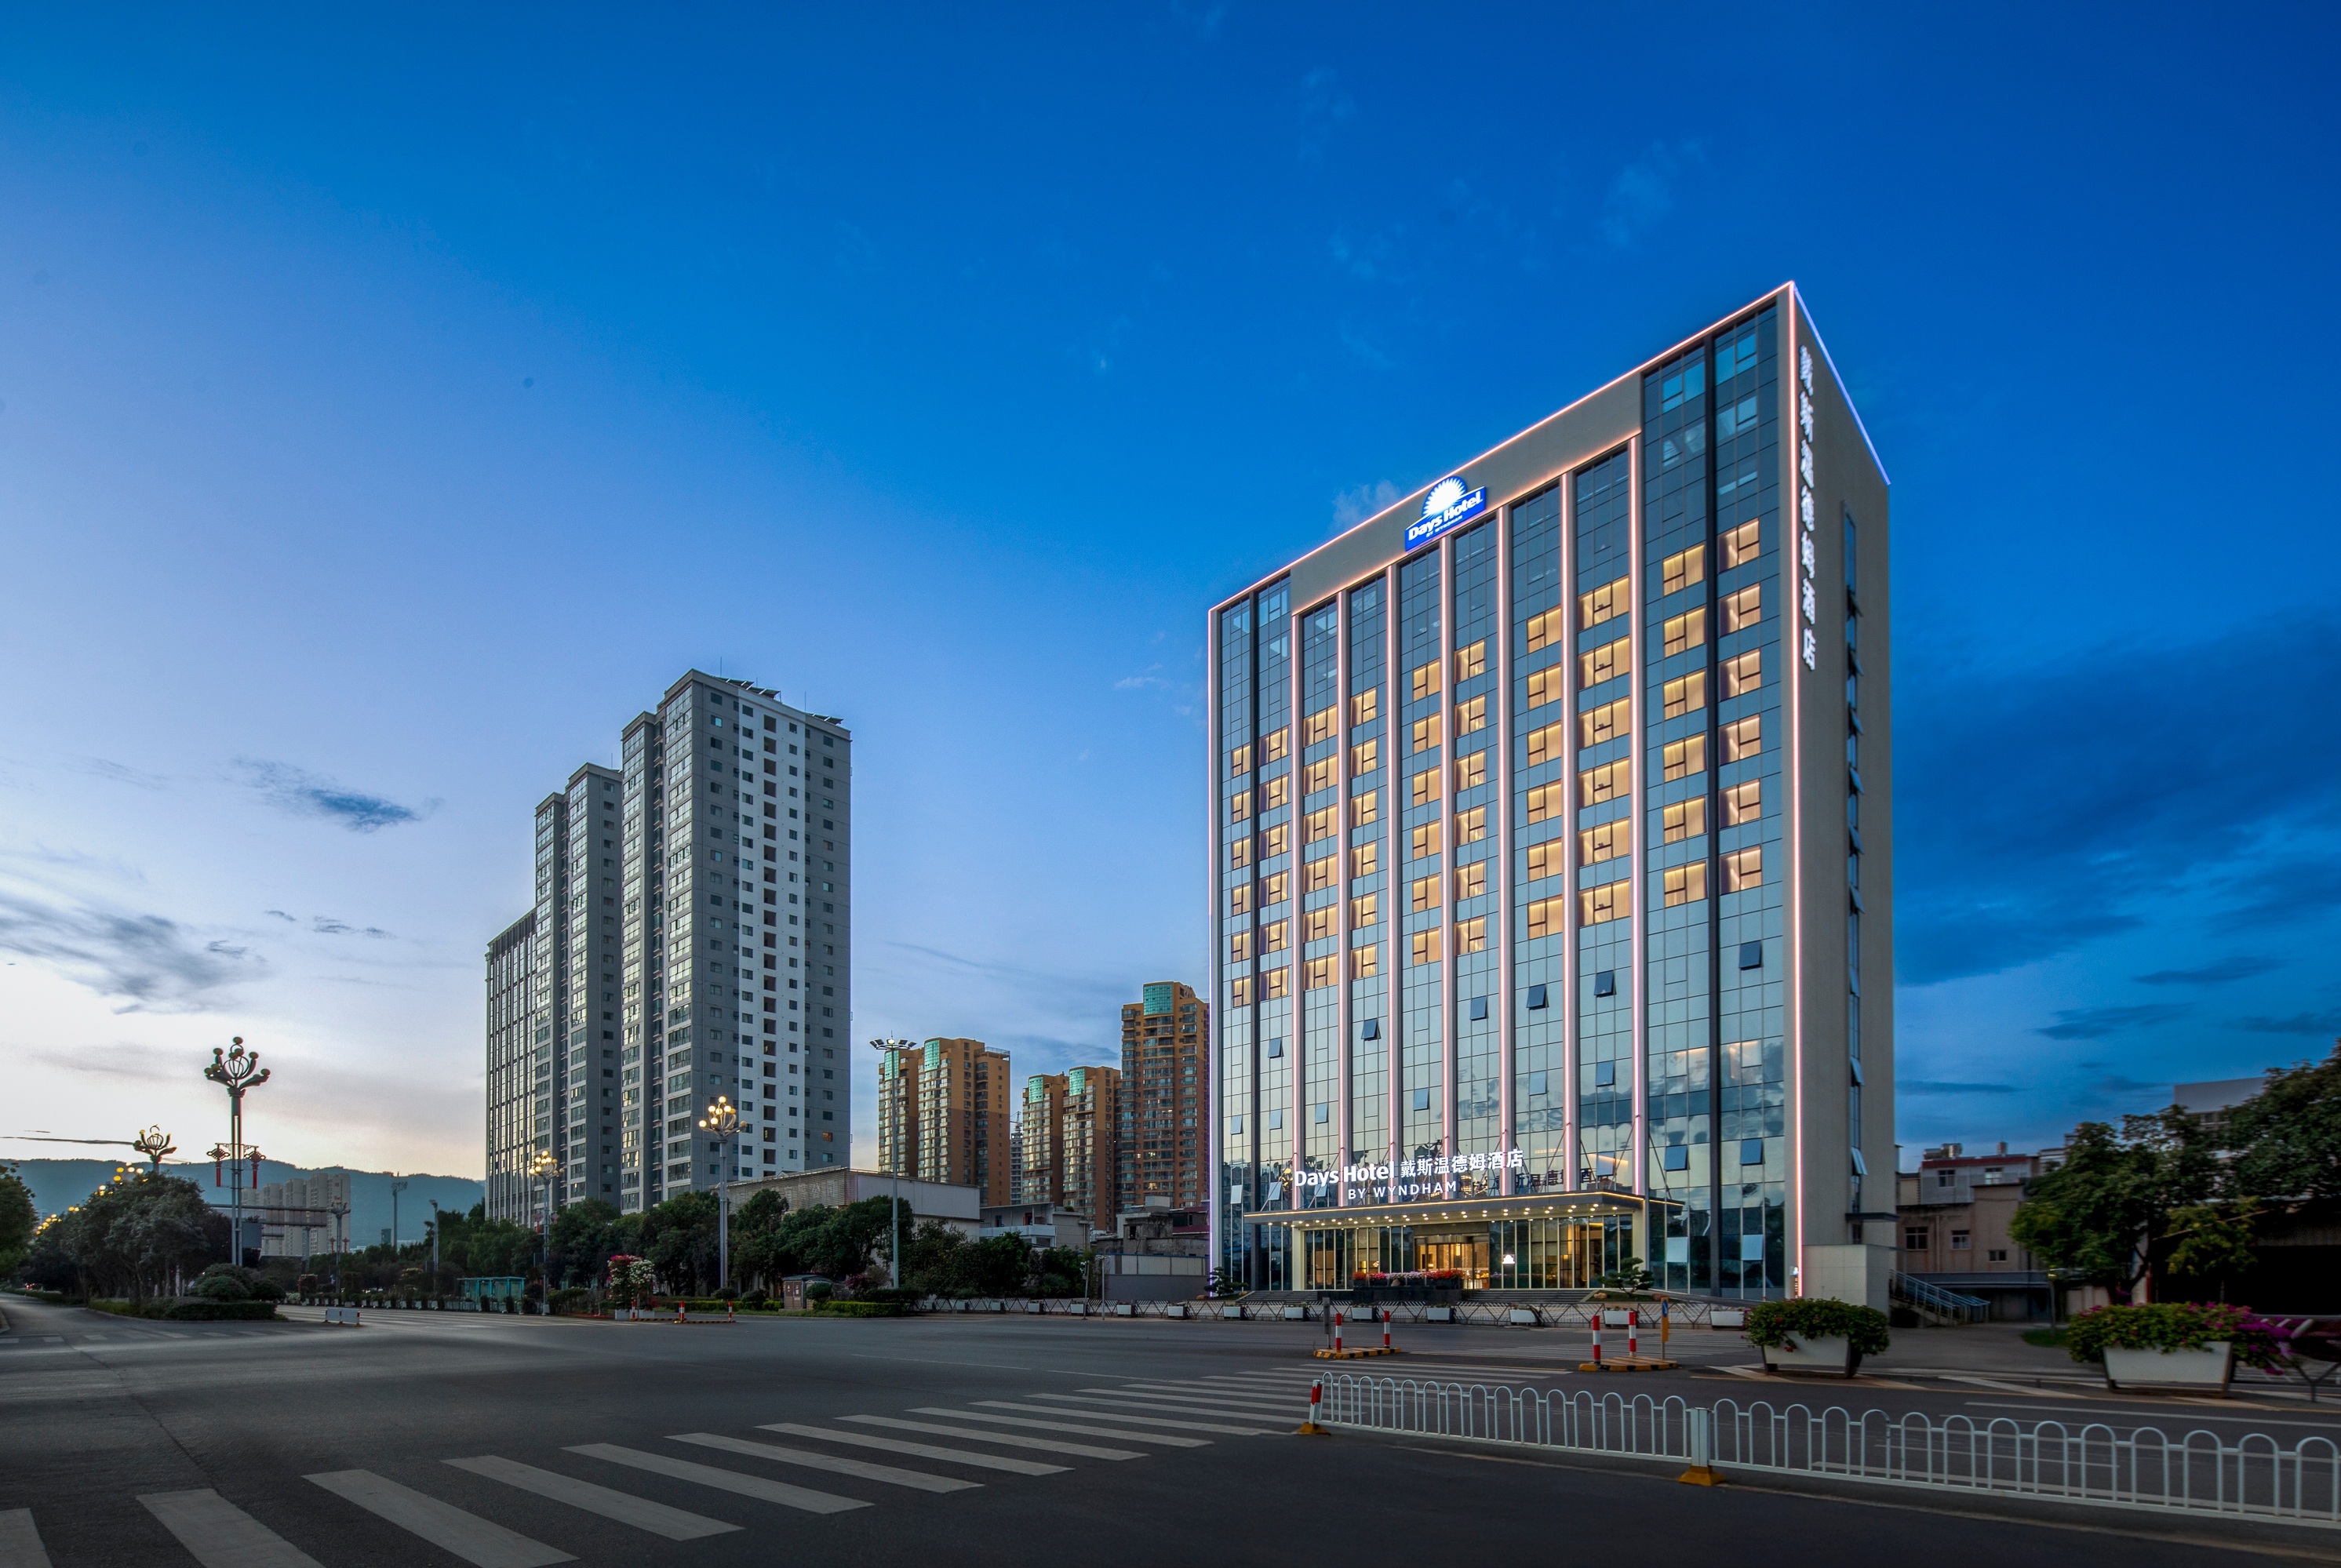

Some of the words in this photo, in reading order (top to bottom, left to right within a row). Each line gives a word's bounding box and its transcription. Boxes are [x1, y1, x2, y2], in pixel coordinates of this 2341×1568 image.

[1408, 515, 1443, 541] Days
[1444, 490, 1484, 522] Hotel
[1294, 1170, 1339, 1187] Days
[1343, 1161, 1395, 1183] Hotel
[1400, 1148, 1524, 1178] 戴斯温德姆酒店
[1348, 1188, 1367, 1200] BY
[1373, 1181, 1457, 1199] WYNDHAM
